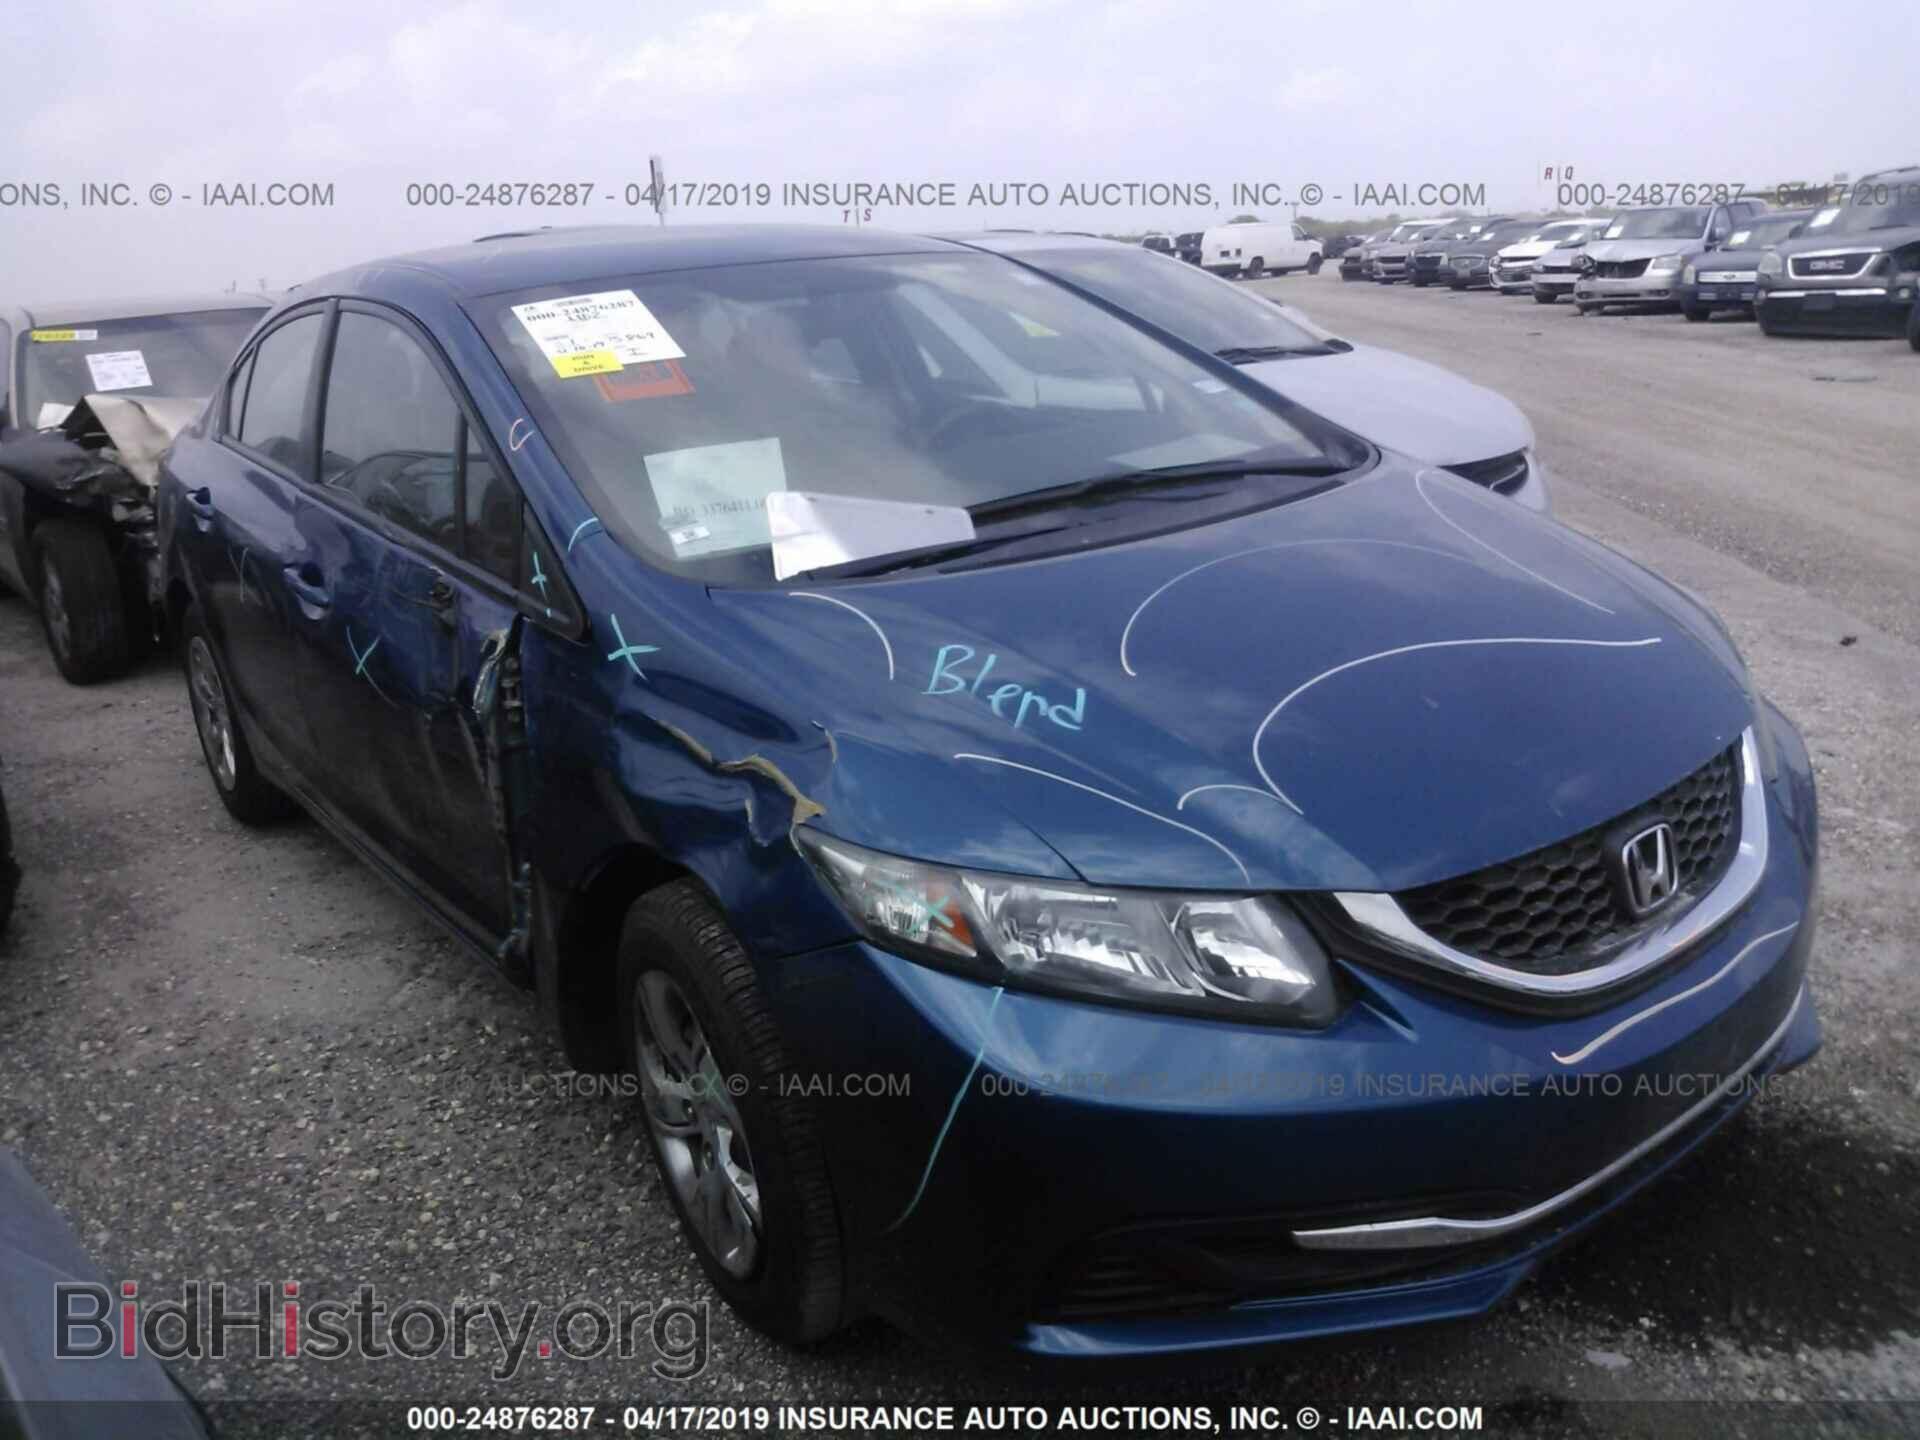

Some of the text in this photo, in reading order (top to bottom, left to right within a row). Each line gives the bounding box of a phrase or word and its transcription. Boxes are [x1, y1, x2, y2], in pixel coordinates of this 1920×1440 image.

[1544, 166, 1554, 181] R
[1564, 166, 1574, 181] Q
[921, 644, 1086, 731] Blend
